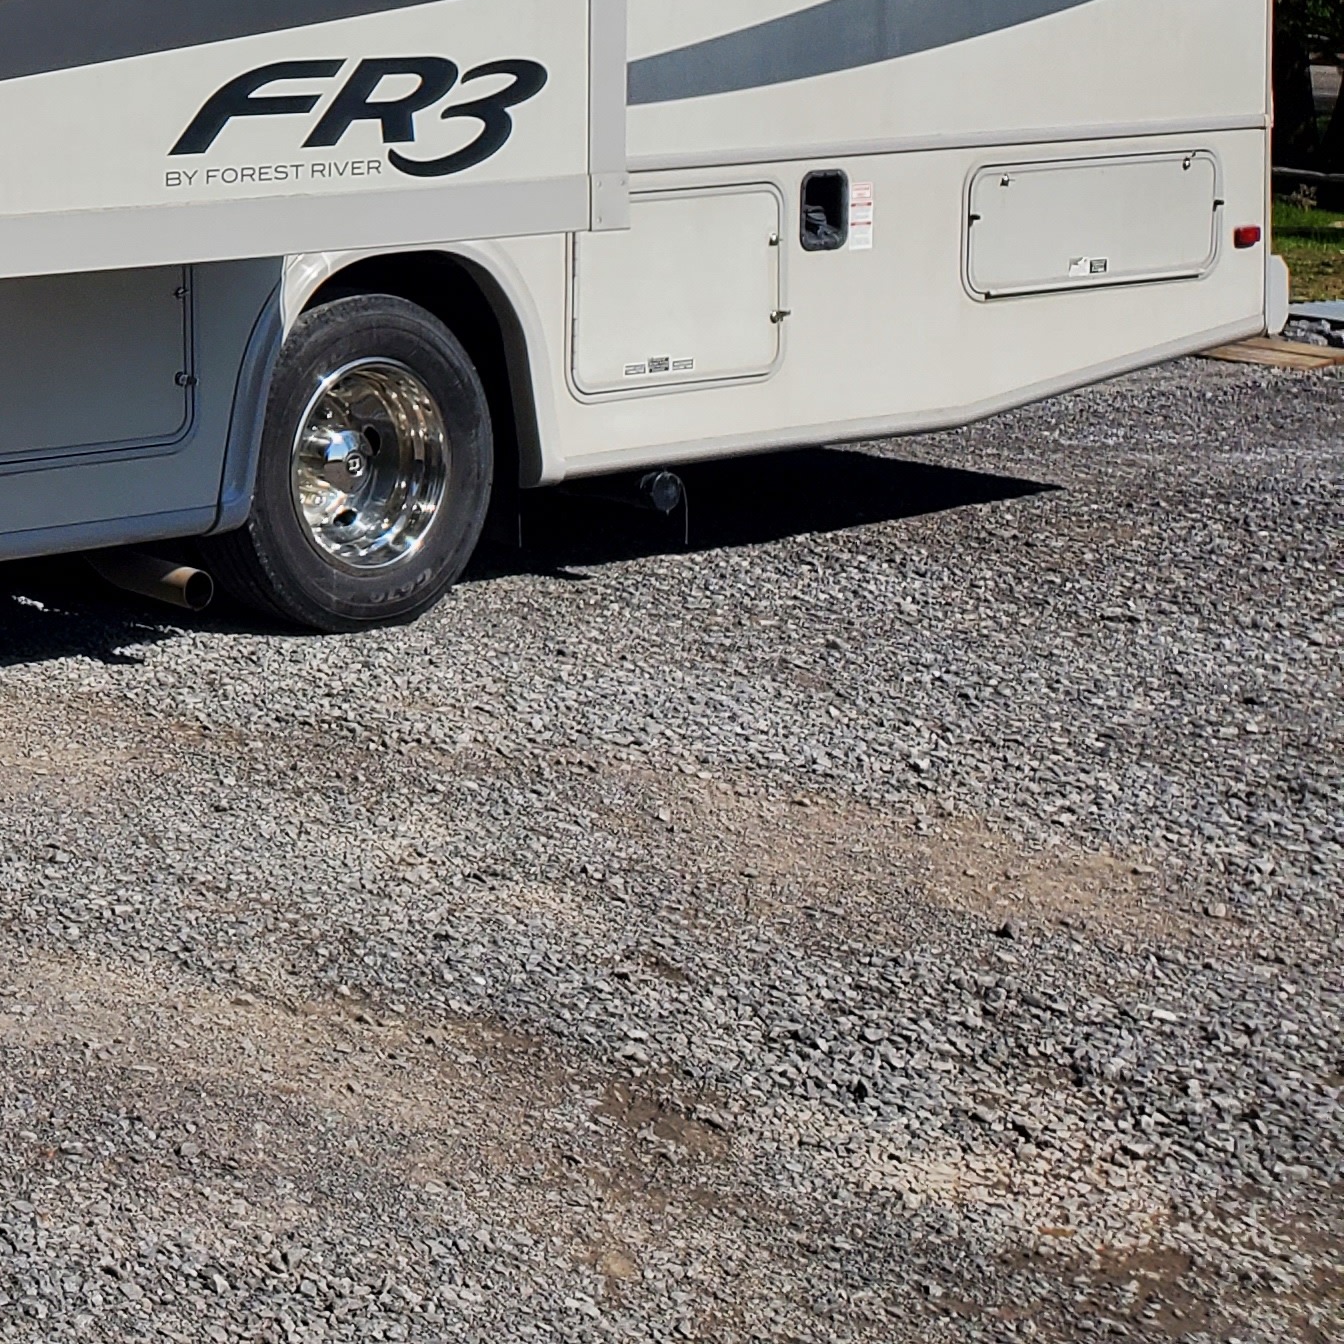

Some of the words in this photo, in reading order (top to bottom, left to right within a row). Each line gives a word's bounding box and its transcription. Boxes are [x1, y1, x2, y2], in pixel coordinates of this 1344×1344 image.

[167, 56, 548, 178] FR3
[165, 169, 200, 187] BY
[206, 163, 306, 185] FOREST
[310, 158, 383, 180] RIVER
